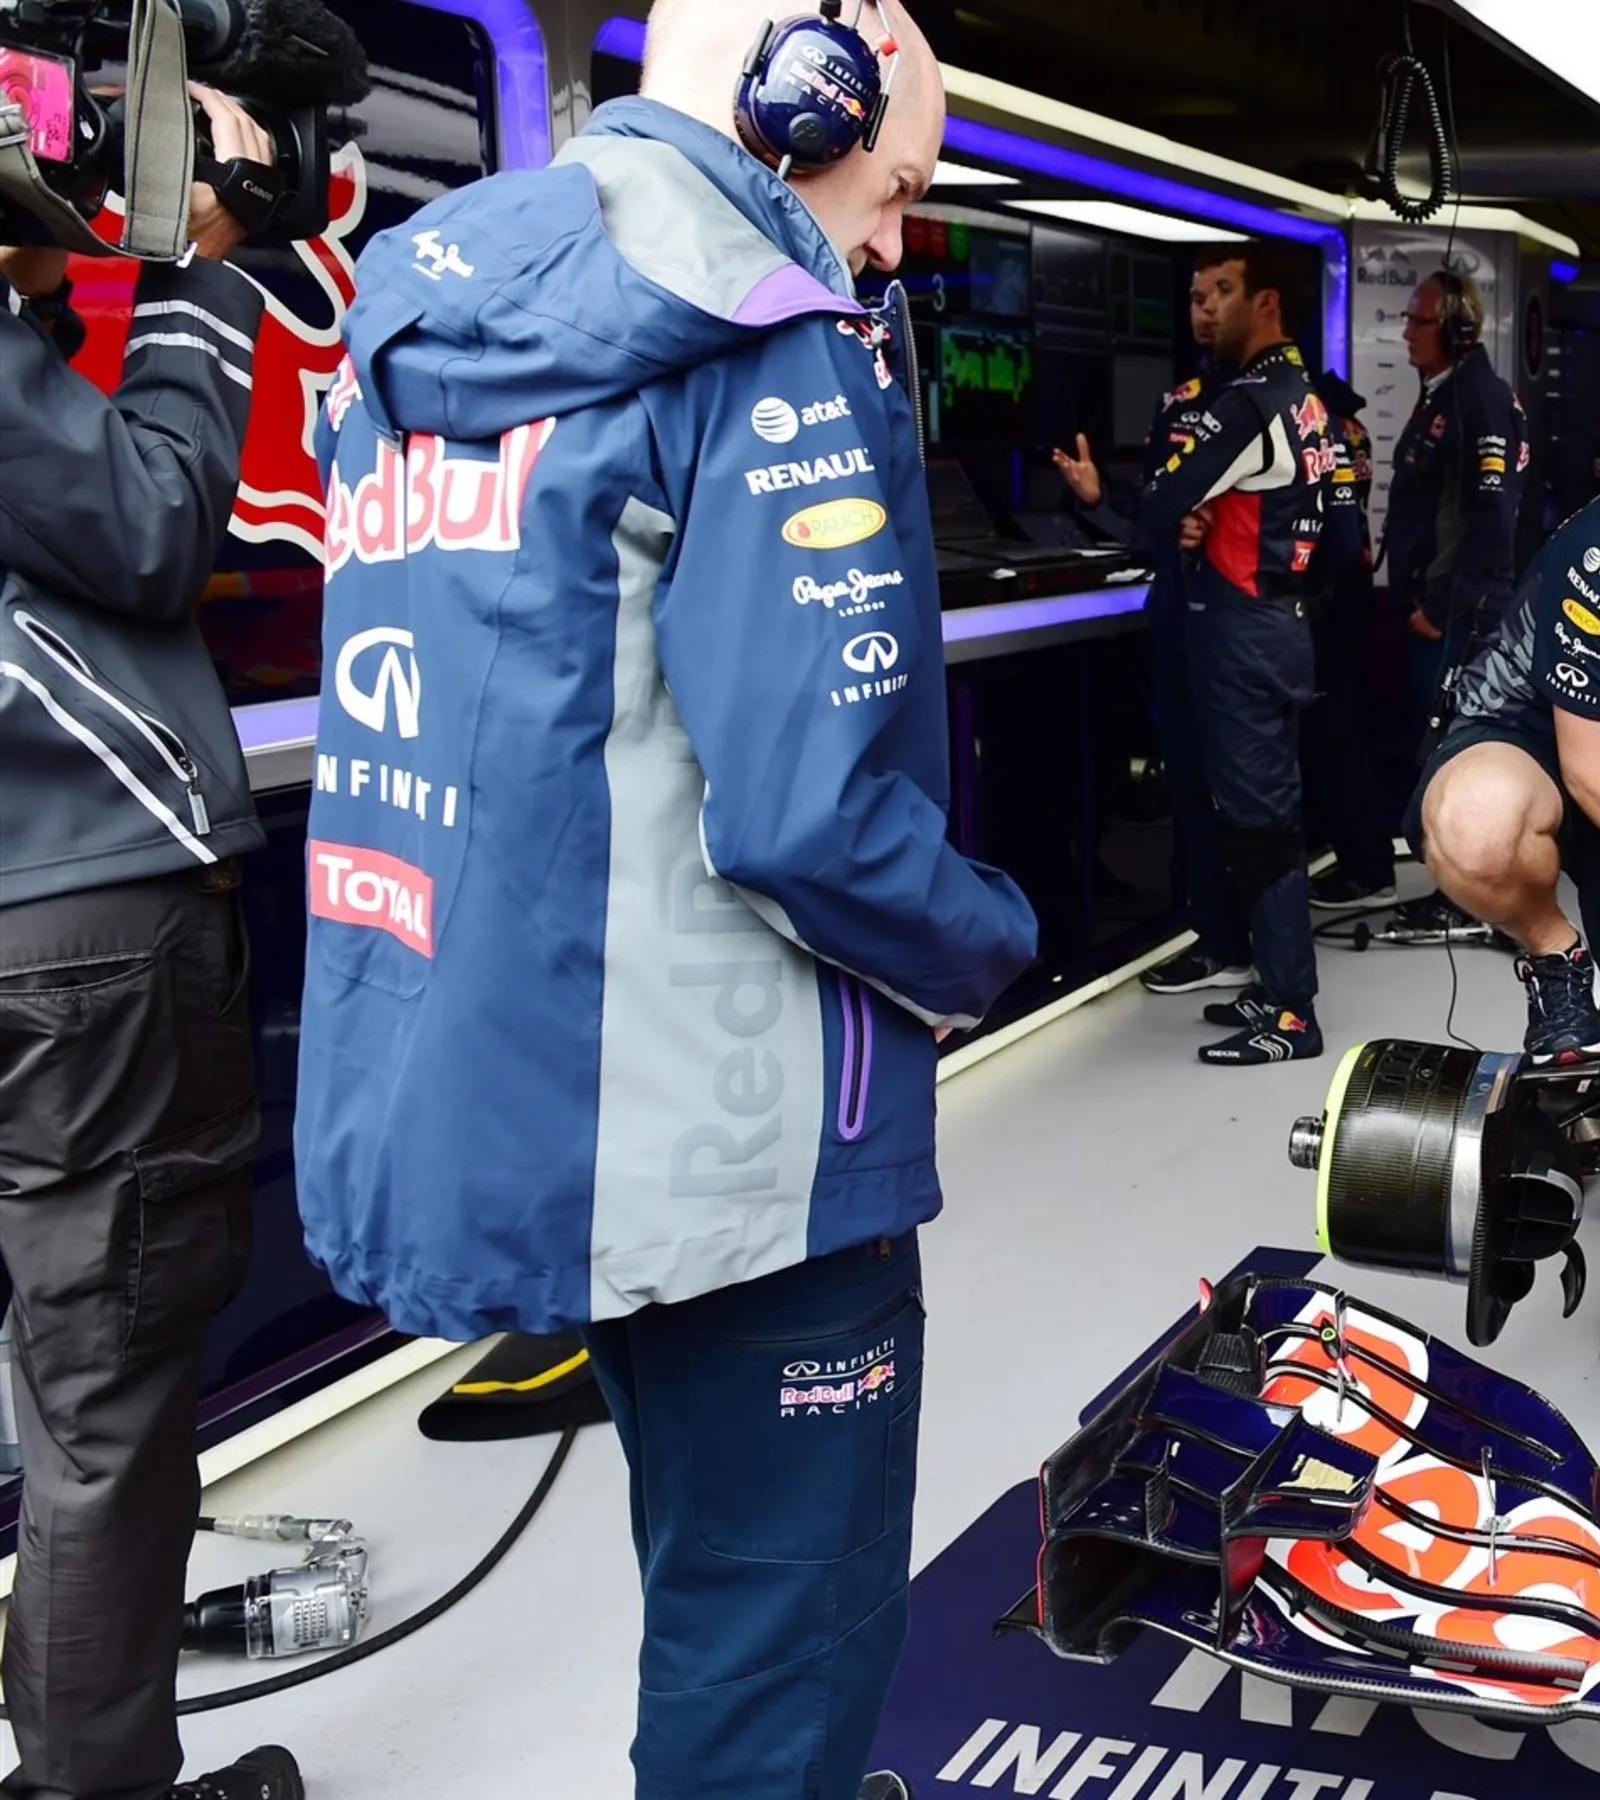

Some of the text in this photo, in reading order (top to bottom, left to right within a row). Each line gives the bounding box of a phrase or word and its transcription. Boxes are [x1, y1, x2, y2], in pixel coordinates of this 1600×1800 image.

[406, 417, 557, 555] Bull
[745, 447, 875, 496] RENAUL
[812, 510, 874, 536] RAUCH
[792, 568, 904, 609] Pepe Jeans
[830, 674, 909, 707] INFINITI
[316, 853, 427, 941] TOTAL
[669, 960, 785, 1199] Red
[825, 1337, 895, 1374] INFINITI
[780, 1382, 855, 1405] Red Bull
[780, 1380, 895, 1418] RACING
